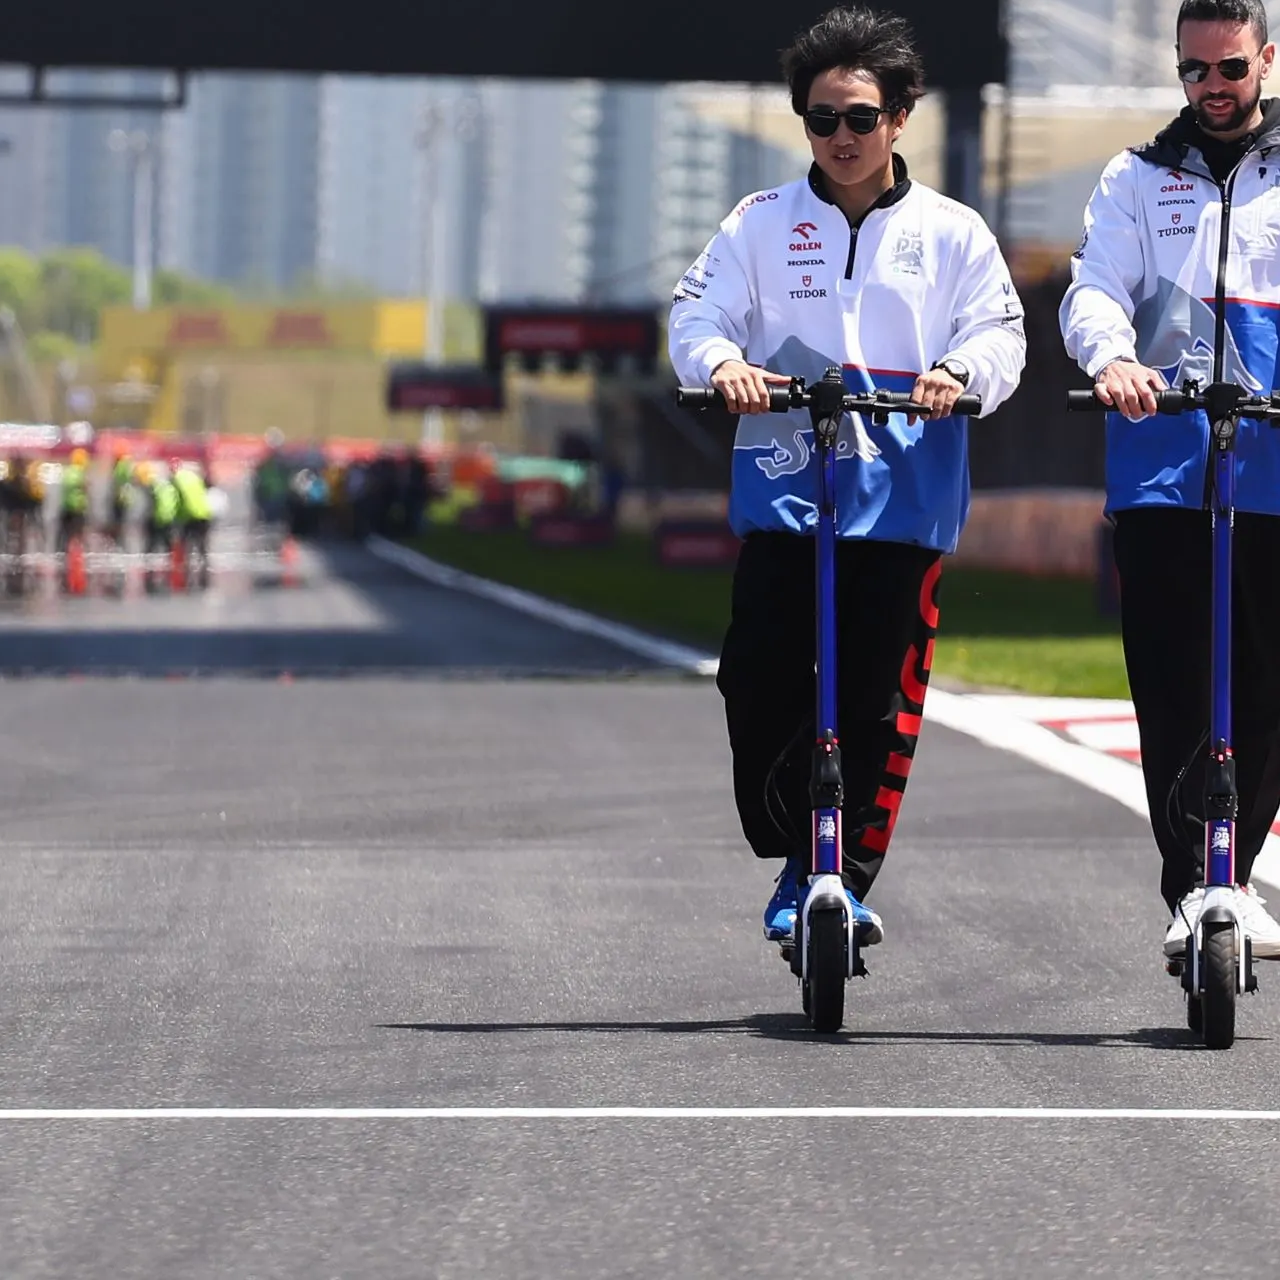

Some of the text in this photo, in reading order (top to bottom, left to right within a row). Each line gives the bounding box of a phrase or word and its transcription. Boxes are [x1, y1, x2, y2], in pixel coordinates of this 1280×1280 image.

[1160, 183, 1194, 193] ORLEN
[736, 192, 779, 216] HUGO
[1157, 199, 1196, 207] HONDA
[1157, 225, 1196, 237] TUDOR
[788, 241, 822, 251] ORLEN
[789, 289, 828, 299] TUDOR
